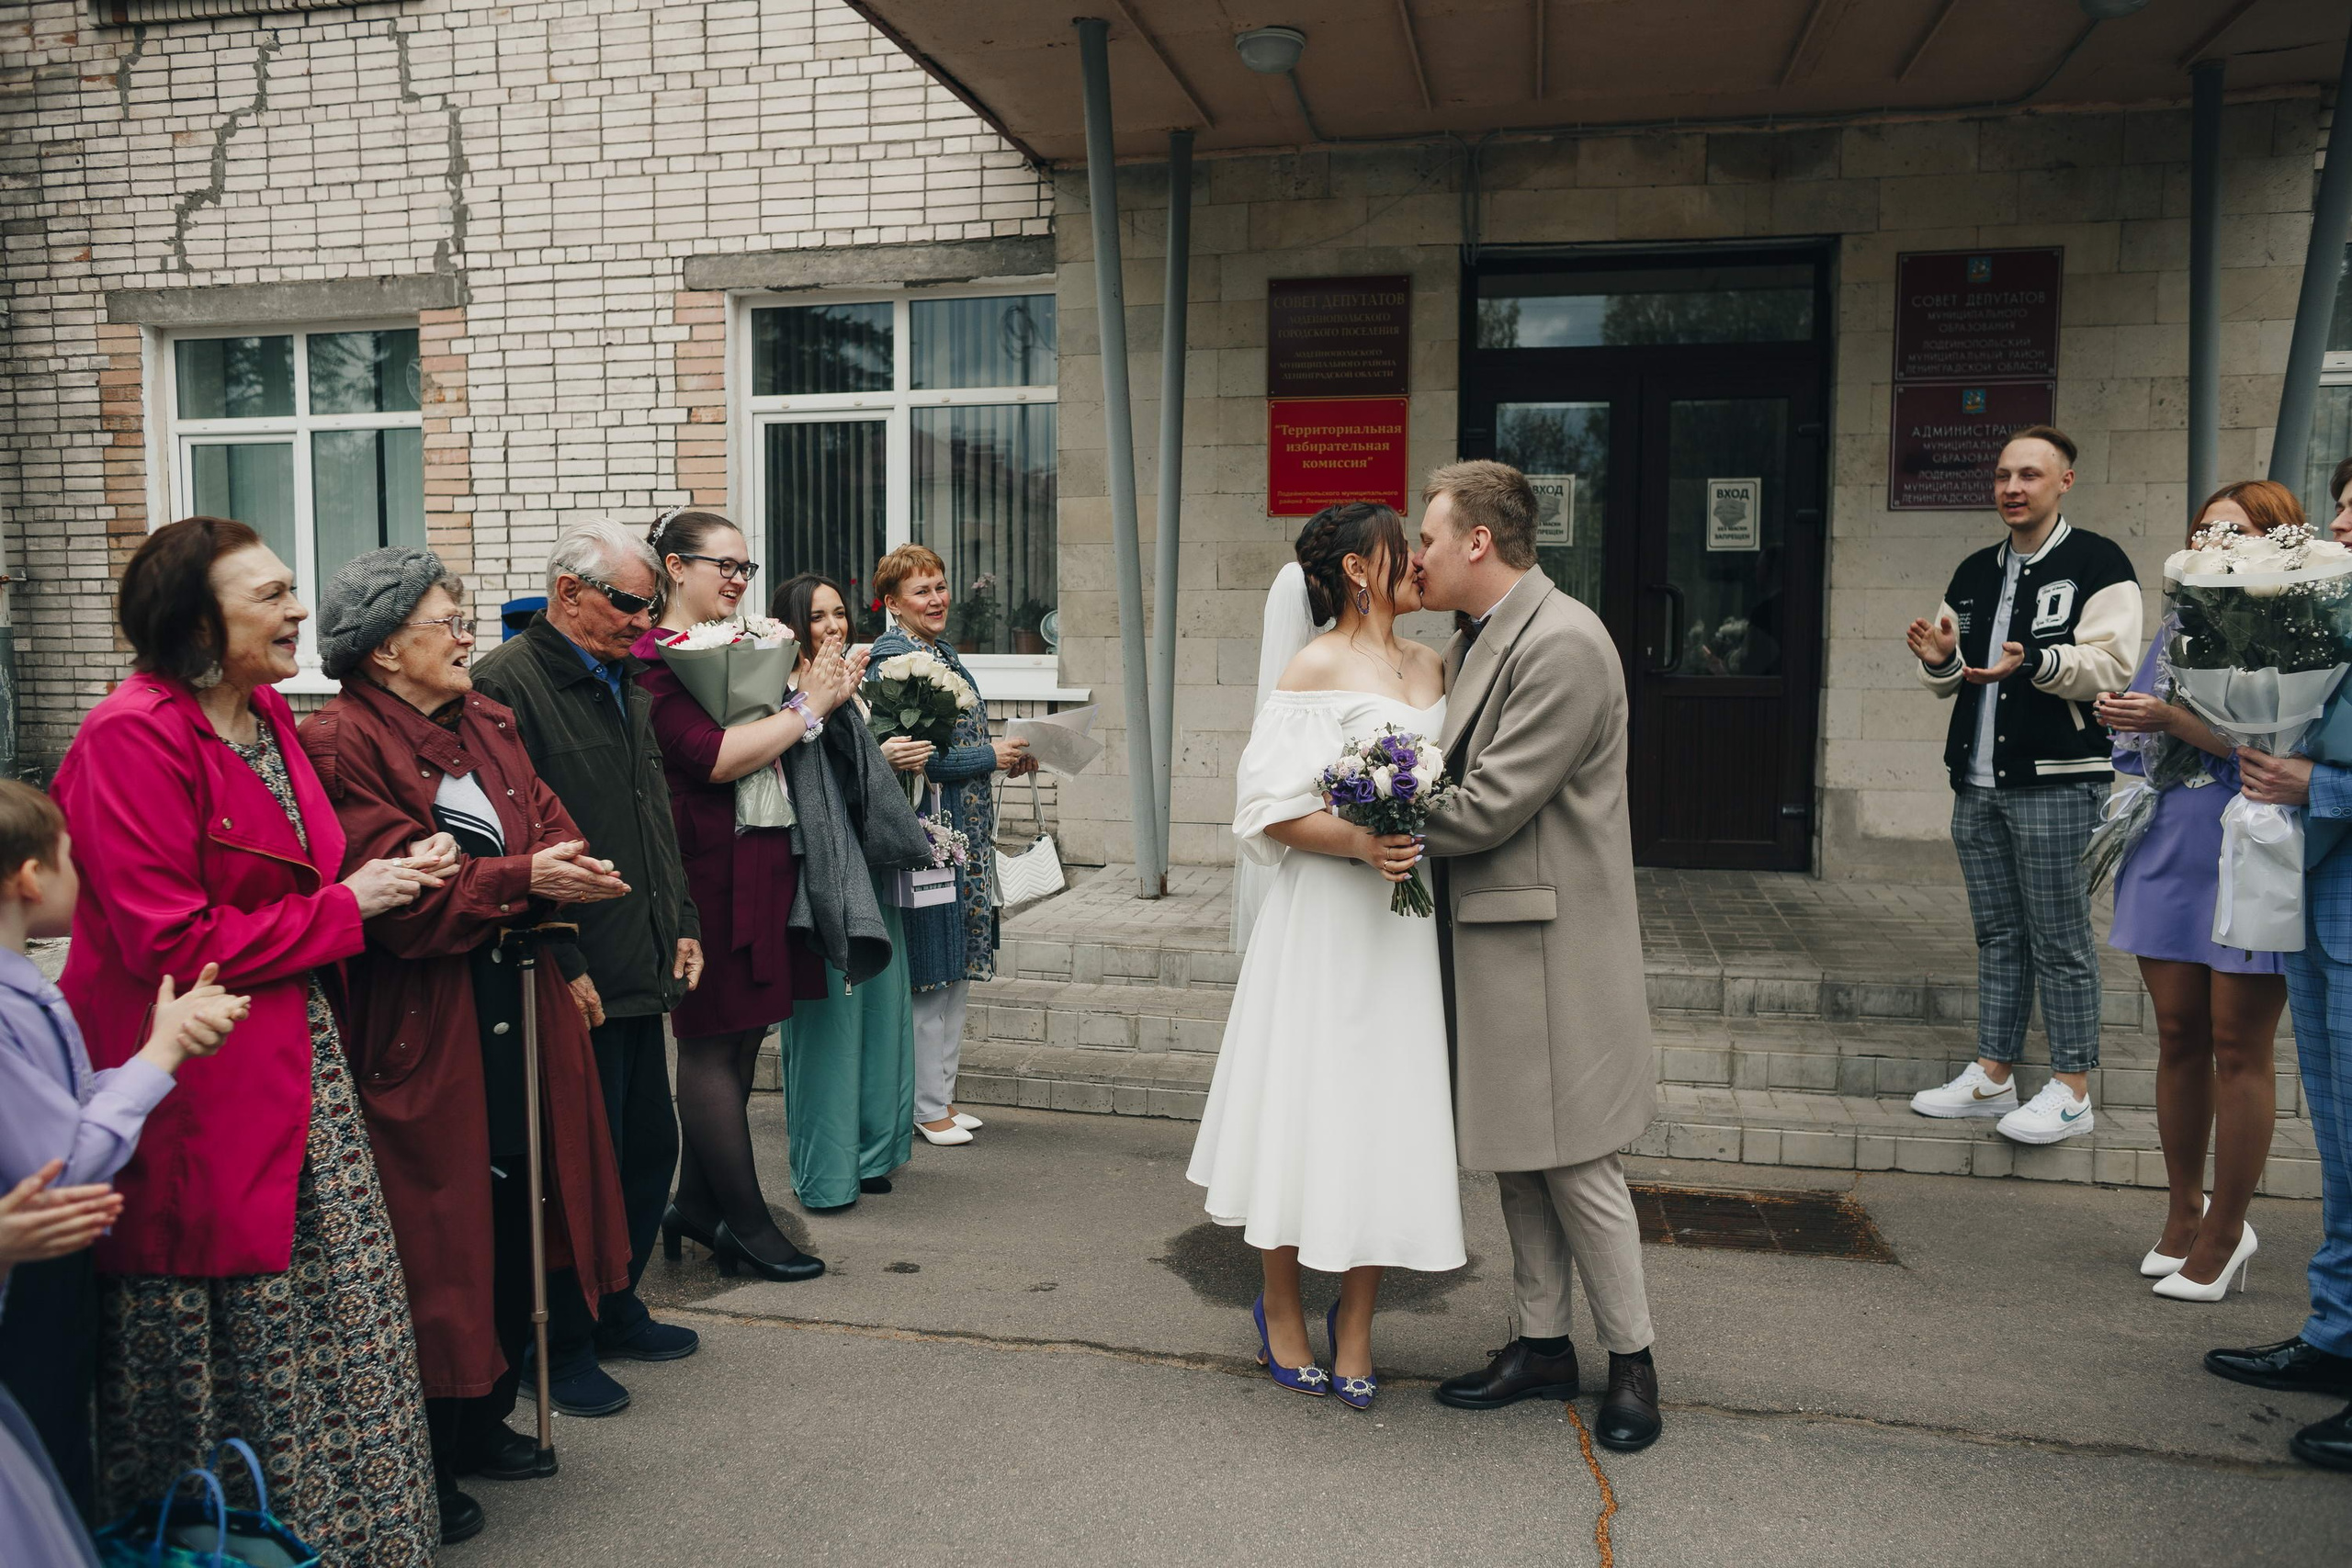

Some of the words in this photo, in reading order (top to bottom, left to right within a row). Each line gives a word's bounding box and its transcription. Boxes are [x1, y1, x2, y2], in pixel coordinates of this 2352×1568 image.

[1273, 295, 1317, 309] СОВЕТ
[1322, 292, 1406, 310] ДЕПУТАТОВ
[1911, 294, 1958, 308] СОВЕТ
[1965, 290, 2046, 307] ДЕПУТАТОВ
[1278, 328, 1340, 339] ГОРОДСКОГО
[1341, 325, 1400, 337] ПОСЕЛЕНИЯ
[1997, 361, 2048, 372] ОБЛАСТИ
[1275, 424, 1402, 438] "Территориальная
[1911, 423, 2030, 438] АДМИНИСТРАЦ
[1286, 441, 1390, 455] избирательная
[1923, 440, 2004, 452] МУНИЦИПАЛЬНО
[1302, 457, 1374, 468] комиссия"
[1932, 453, 1997, 463] ОБРАЗОВАН
[1918, 468, 1995, 480] ЛОДЕЙНОПОЛЬ
[1716, 489, 1749, 500] ВХОД
